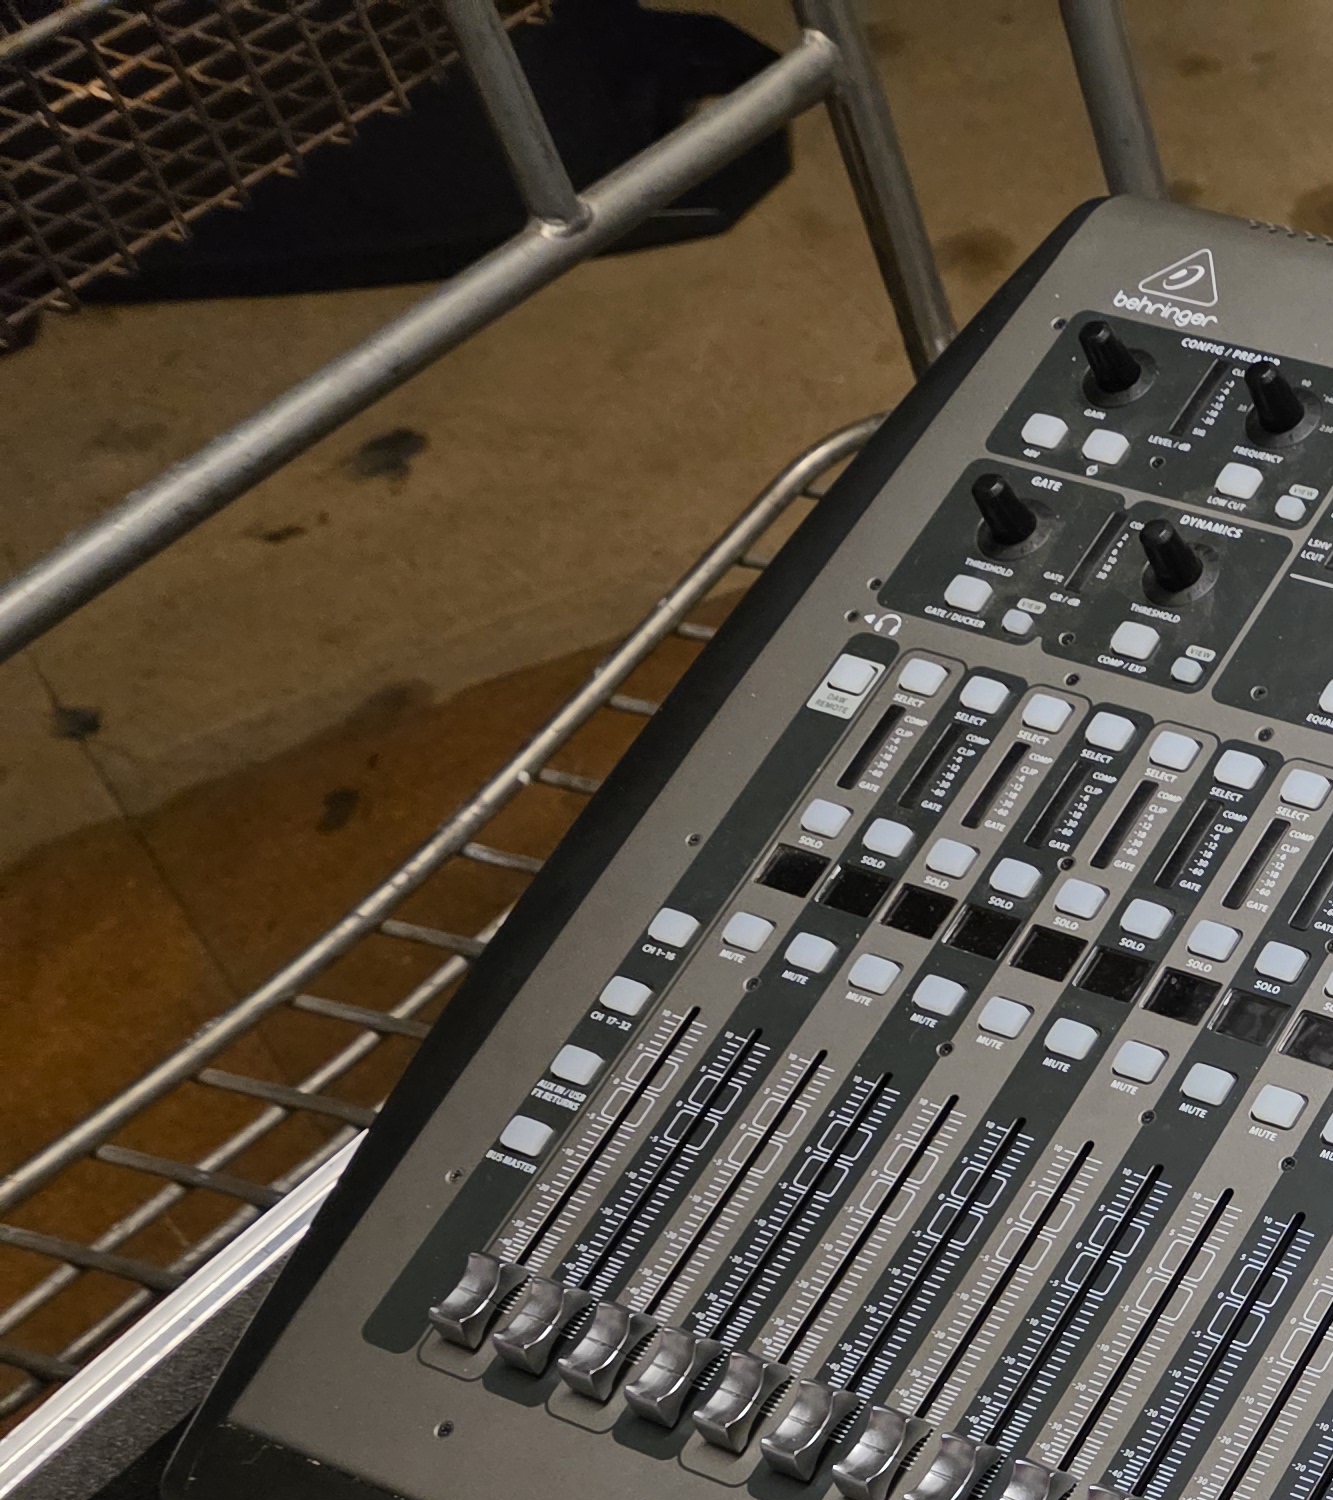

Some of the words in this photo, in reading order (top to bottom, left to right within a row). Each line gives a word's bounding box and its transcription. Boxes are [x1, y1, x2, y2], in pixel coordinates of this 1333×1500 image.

[1113, 289, 1218, 327] behringer
[1181, 337, 1225, 356] CONFIG
[1083, 408, 1106, 420] GAIN
[1148, 435, 1173, 449] LEVEL
[1232, 445, 1284, 464] FREQUENCY
[1031, 476, 1063, 493] GATE
[1206, 496, 1229, 509] LOW
[1227, 500, 1247, 512] CUT
[1179, 514, 1244, 539] DYNAMICS
[1300, 549, 1326, 563] LCUT
[965, 557, 1014, 578] THRESHOLD
[1043, 571, 1065, 583] GATE
[924, 605, 947, 619] GATE
[951, 612, 986, 629] DUCKER
[1130, 602, 1181, 624] THRESHOLD
[1097, 654, 1125, 668] COMP
[1128, 663, 1147, 674] EXP
[815, 698, 849, 715] REMOTE
[826, 692, 849, 704] DAW
[954, 711, 988, 727] SELECT
[719, 948, 748, 964] MUTE
[590, 1010, 605, 1022] CH
[536, 1078, 554, 1091] AUX
[569, 1089, 588, 1102] USB
[530, 1088, 545, 1100] FX
[544, 1091, 581, 1112] RETURNS
[485, 1149, 503, 1162] BUS
[501, 1155, 537, 1174] MASTER
